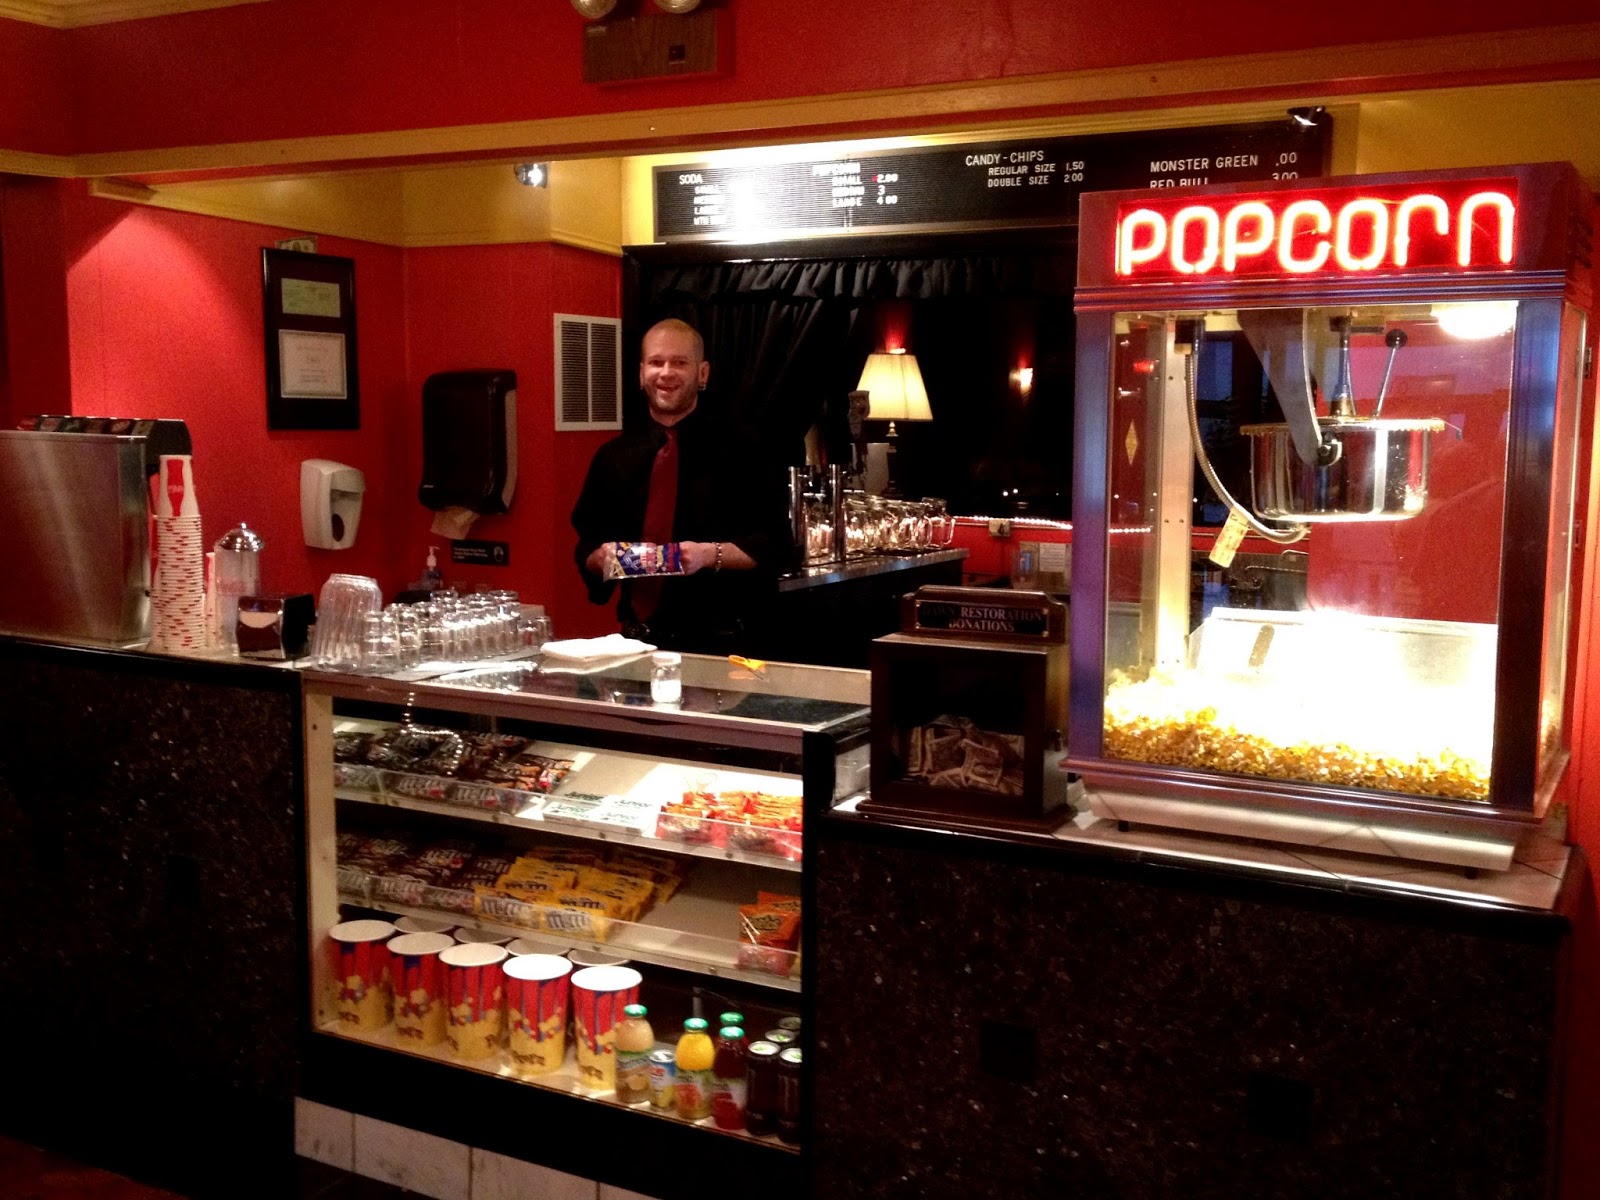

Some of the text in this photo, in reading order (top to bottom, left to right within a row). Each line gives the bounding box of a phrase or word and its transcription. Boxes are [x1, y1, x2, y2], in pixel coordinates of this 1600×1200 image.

[1010, 150, 1044, 163] CHIPS
[988, 161, 1085, 176] REGULAR SIZE 1.50
[1150, 157, 1209, 173] MONSTER
[1215, 154, 1259, 168] GREEN
[679, 174, 703, 185] SODA
[987, 177, 1022, 188] DOUBLE
[1028, 175, 1050, 185] SIZE
[1150, 179, 1174, 189] RED
[877, 185, 886, 196] 3
[961, 605, 1042, 622] RESTORATION
[949, 618, 1015, 633] DONATIONS
